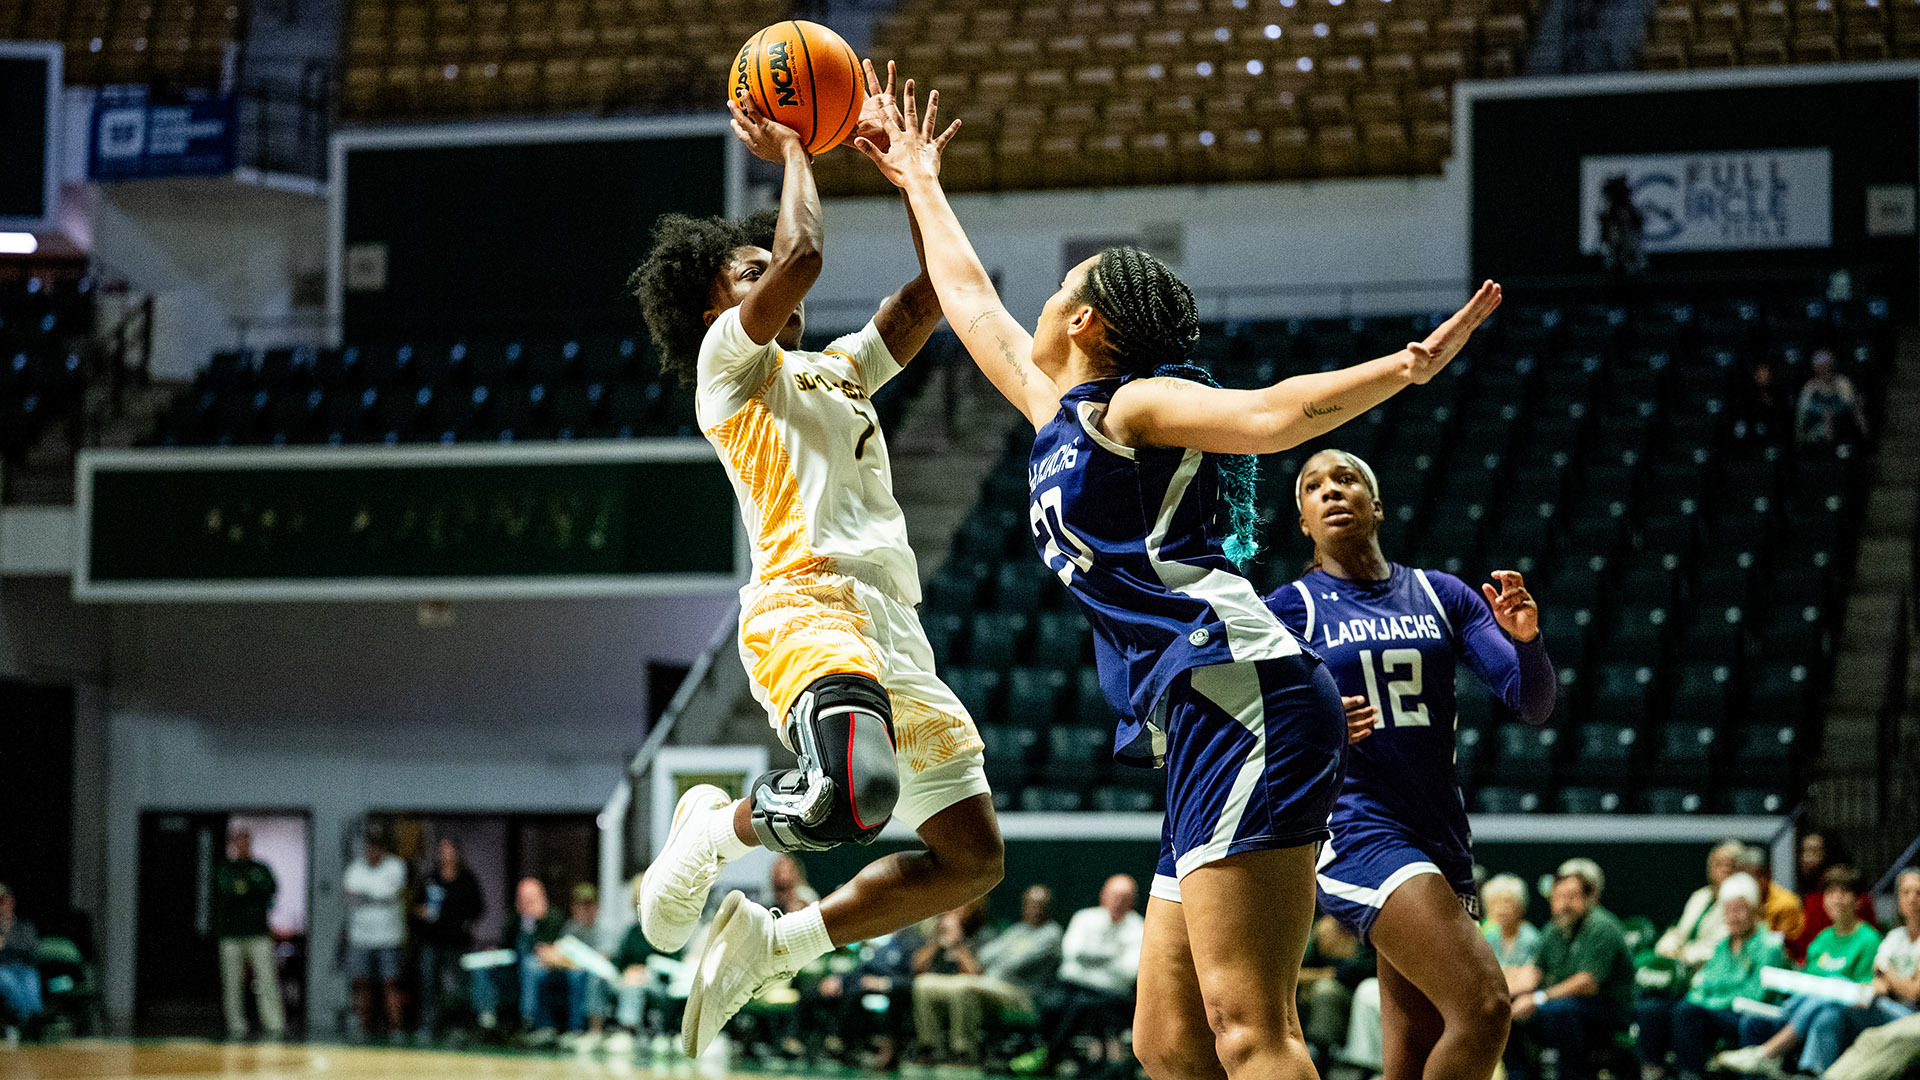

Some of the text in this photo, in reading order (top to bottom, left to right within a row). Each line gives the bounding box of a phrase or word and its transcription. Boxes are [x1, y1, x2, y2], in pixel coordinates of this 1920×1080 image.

[767, 40, 799, 108] NCAA
[1323, 614, 1442, 648] LADYJACKS
[1359, 648, 1431, 730] 12
